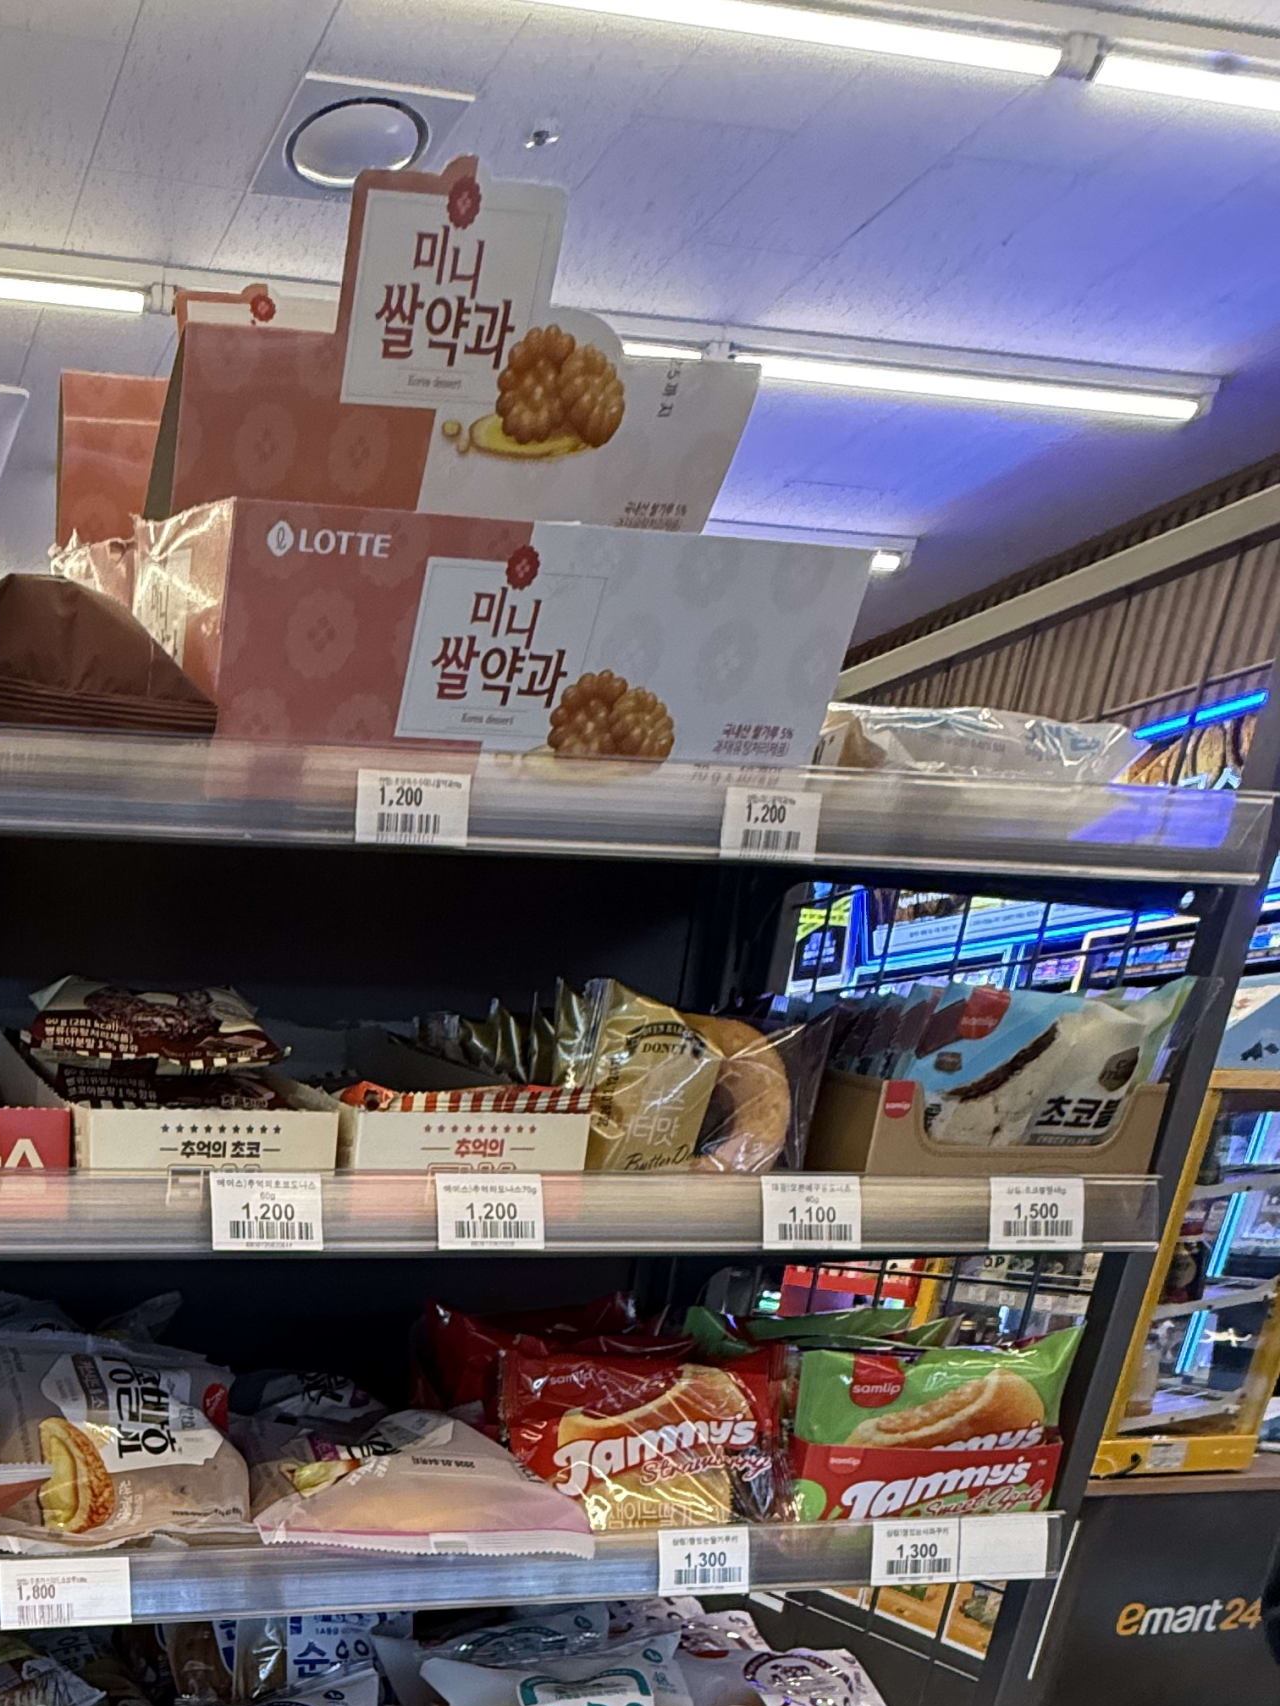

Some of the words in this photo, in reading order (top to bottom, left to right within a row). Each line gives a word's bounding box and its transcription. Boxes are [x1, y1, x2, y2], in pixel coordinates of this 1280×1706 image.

[413, 225, 485, 299] 미니
[375, 283, 515, 370] 쌀약과
[298, 528, 392, 558] LOTTE
[470, 586, 542, 650] 미니
[431, 635, 568, 709] 쌀약과
[378, 786, 423, 807] 1,200
[744, 804, 787, 824] 1,200
[179, 1140, 228, 1159] 추억의
[231, 1140, 262, 1159] 초코
[454, 1138, 506, 1158] 추억의
[240, 1202, 296, 1222] 1,200
[465, 1202, 518, 1222] 1,200
[788, 1206, 837, 1225] 1,100
[1013, 1203, 1060, 1220] 1,500
[851, 1382, 902, 1395] samlip
[551, 1411, 758, 1496] Jammy's
[840, 1456, 1032, 1521] Jammy's
[684, 1551, 728, 1569] 1,300
[896, 1543, 939, 1560] 1,300
[17, 1583, 56, 1601] 1,800
[1115, 1596, 1264, 1637] emart24
